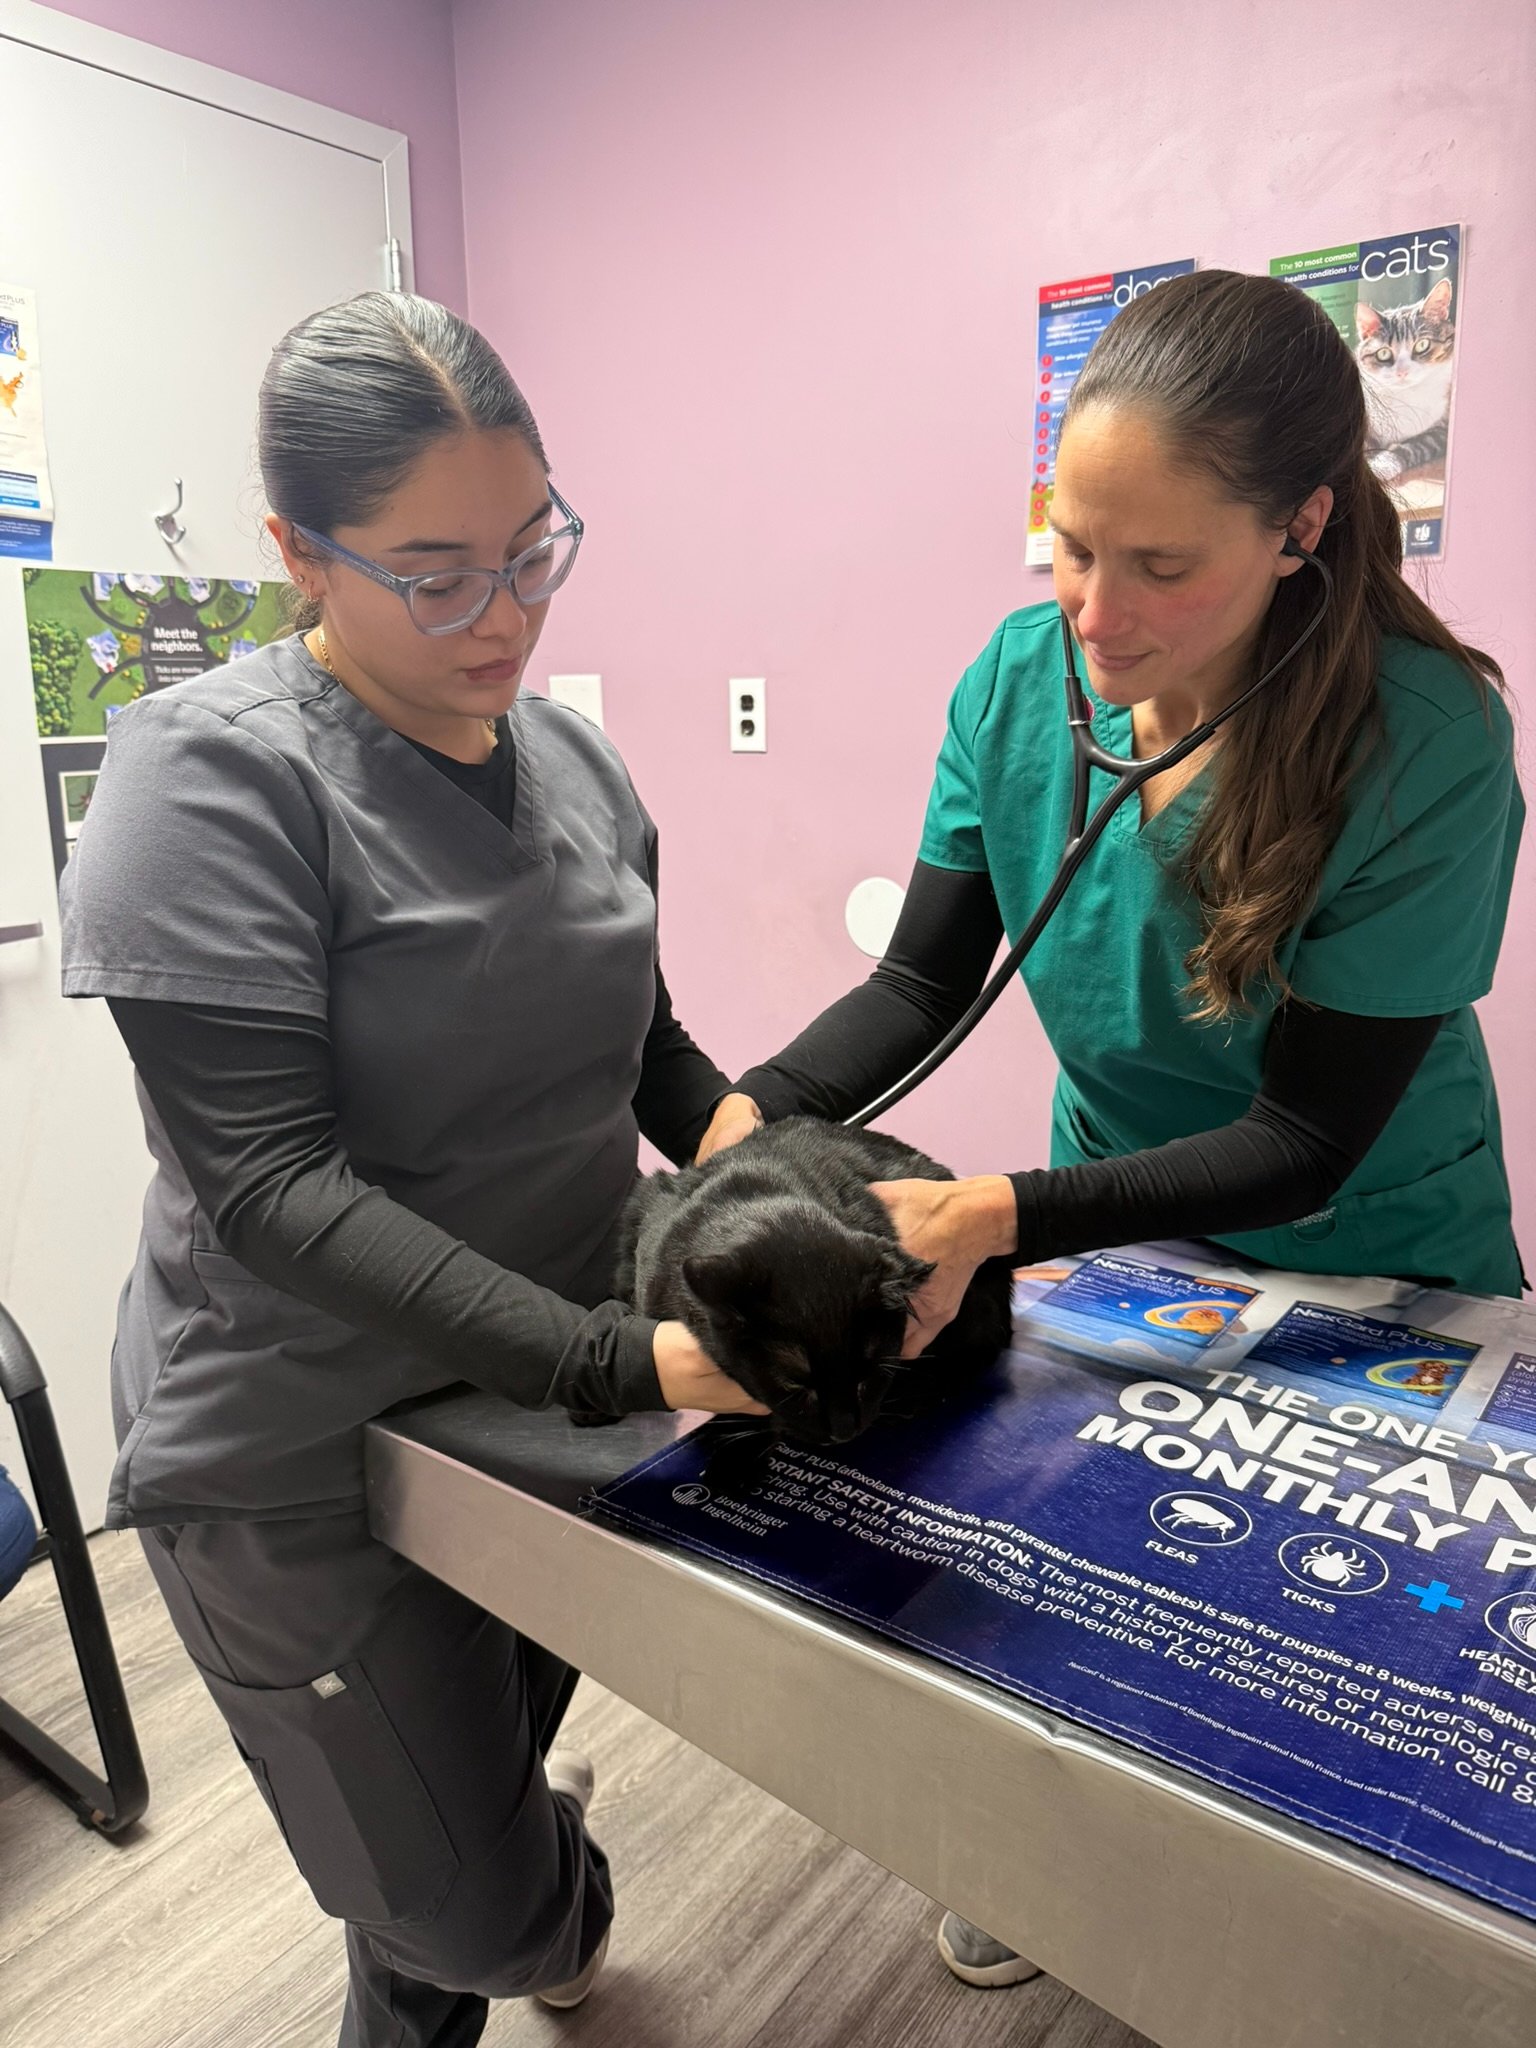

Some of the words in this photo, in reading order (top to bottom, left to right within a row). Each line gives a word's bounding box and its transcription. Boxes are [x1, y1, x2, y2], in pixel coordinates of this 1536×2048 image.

[1280, 262, 1293, 271] The
[1294, 260, 1303, 268] 10
[1304, 257, 1323, 267] most
[1324, 251, 1357, 263] common
[1361, 235, 1449, 282] cats
[1284, 273, 1307, 283] health
[1308, 266, 1347, 279] conditions
[1348, 263, 1359, 272] for
[1071, 295, 1102, 306] conditions
[150, 640, 203, 654] neighbors.
[154, 626, 180, 639] Meet
[181, 628, 198, 639] the
[1177, 1280, 1226, 1296] PLUS
[1388, 1330, 1446, 1351] PLUS
[1206, 1368, 1319, 1417] THE
[1328, 1405, 1469, 1459] ONE
[1486, 1441, 1536, 1480] Y
[1075, 1413, 1470, 1553] MONTHLY
[700, 1502, 768, 1537] Ingelheim
[714, 1495, 788, 1529] Boehringer
[1145, 1540, 1199, 1564] FLEAS
[805, 1454, 840, 1471] PLUS
[837, 1464, 905, 1500] (afoxolaner,
[907, 1494, 982, 1527] moxidectin,
[984, 1518, 1015, 1534] and
[1011, 1528, 1072, 1563] pyrantel
[1071, 1555, 1142, 1589] chewable
[1143, 1582, 1203, 1612] tablets)
[1202, 1603, 1217, 1617] is
[1218, 1609, 1254, 1631] safe
[1255, 1624, 1283, 1642] for
[1281, 1635, 1353, 1667] puppies
[1354, 1663, 1375, 1676] at
[1376, 1668, 1390, 1681] 8
[1392, 1676, 1456, 1704] weeks,
[1461, 1694, 1536, 1739] weighin
[827, 1479, 899, 1515] SAFETY
[896, 1508, 1034, 1569] INFORMATION:
[1038, 1560, 1077, 1587] The
[1080, 1581, 1140, 1611] most
[1142, 1603, 1263, 1657] frequently
[1265, 1650, 1380, 1703] reported
[1384, 1696, 1495, 1743] adverse
[1281, 1587, 1337, 1614] TICKS
[763, 1490, 834, 1522] starting
[832, 1517, 848, 1528] a
[848, 1522, 954, 1568] heartworm
[956, 1560, 1035, 1605] disease
[1034, 1599, 1156, 1653] preventive.
[1163, 1645, 1208, 1671] For
[1208, 1666, 1277, 1700] more
[1281, 1693, 1446, 1767] information,
[1454, 1760, 1507, 1793] call
[1511, 1783, 1536, 1807] 8
[813, 1489, 848, 1511] Use
[850, 1506, 890, 1530] with
[891, 1524, 963, 1554] caution
[964, 1545, 985, 1562] in
[987, 1556, 1039, 1590] dogs
[1041, 1583, 1090, 1608] with
[1090, 1602, 1107, 1615] a
[1108, 1607, 1192, 1647] history
[1195, 1641, 1225, 1659] of
[1224, 1653, 1329, 1703] seizures
[1334, 1696, 1366, 1714] or
[1369, 1710, 1518, 1777] neurologic
[1098, 1672, 1106, 1680] is
[1110, 1678, 1145, 1696] registered
[1144, 1691, 1179, 1708] trademark
[1187, 1707, 1226, 1730] Boehringer
[1226, 1726, 1263, 1745] Ingelheim
[1262, 1740, 1290, 1757] Animal
[1289, 1751, 1315, 1769] Health
[1314, 1763, 1343, 1782] France,
[1343, 1777, 1364, 1790] used
[1363, 1785, 1389, 1796] under
[1388, 1790, 1419, 1808] license.
[1450, 1818, 1498, 1847] Boehringer
